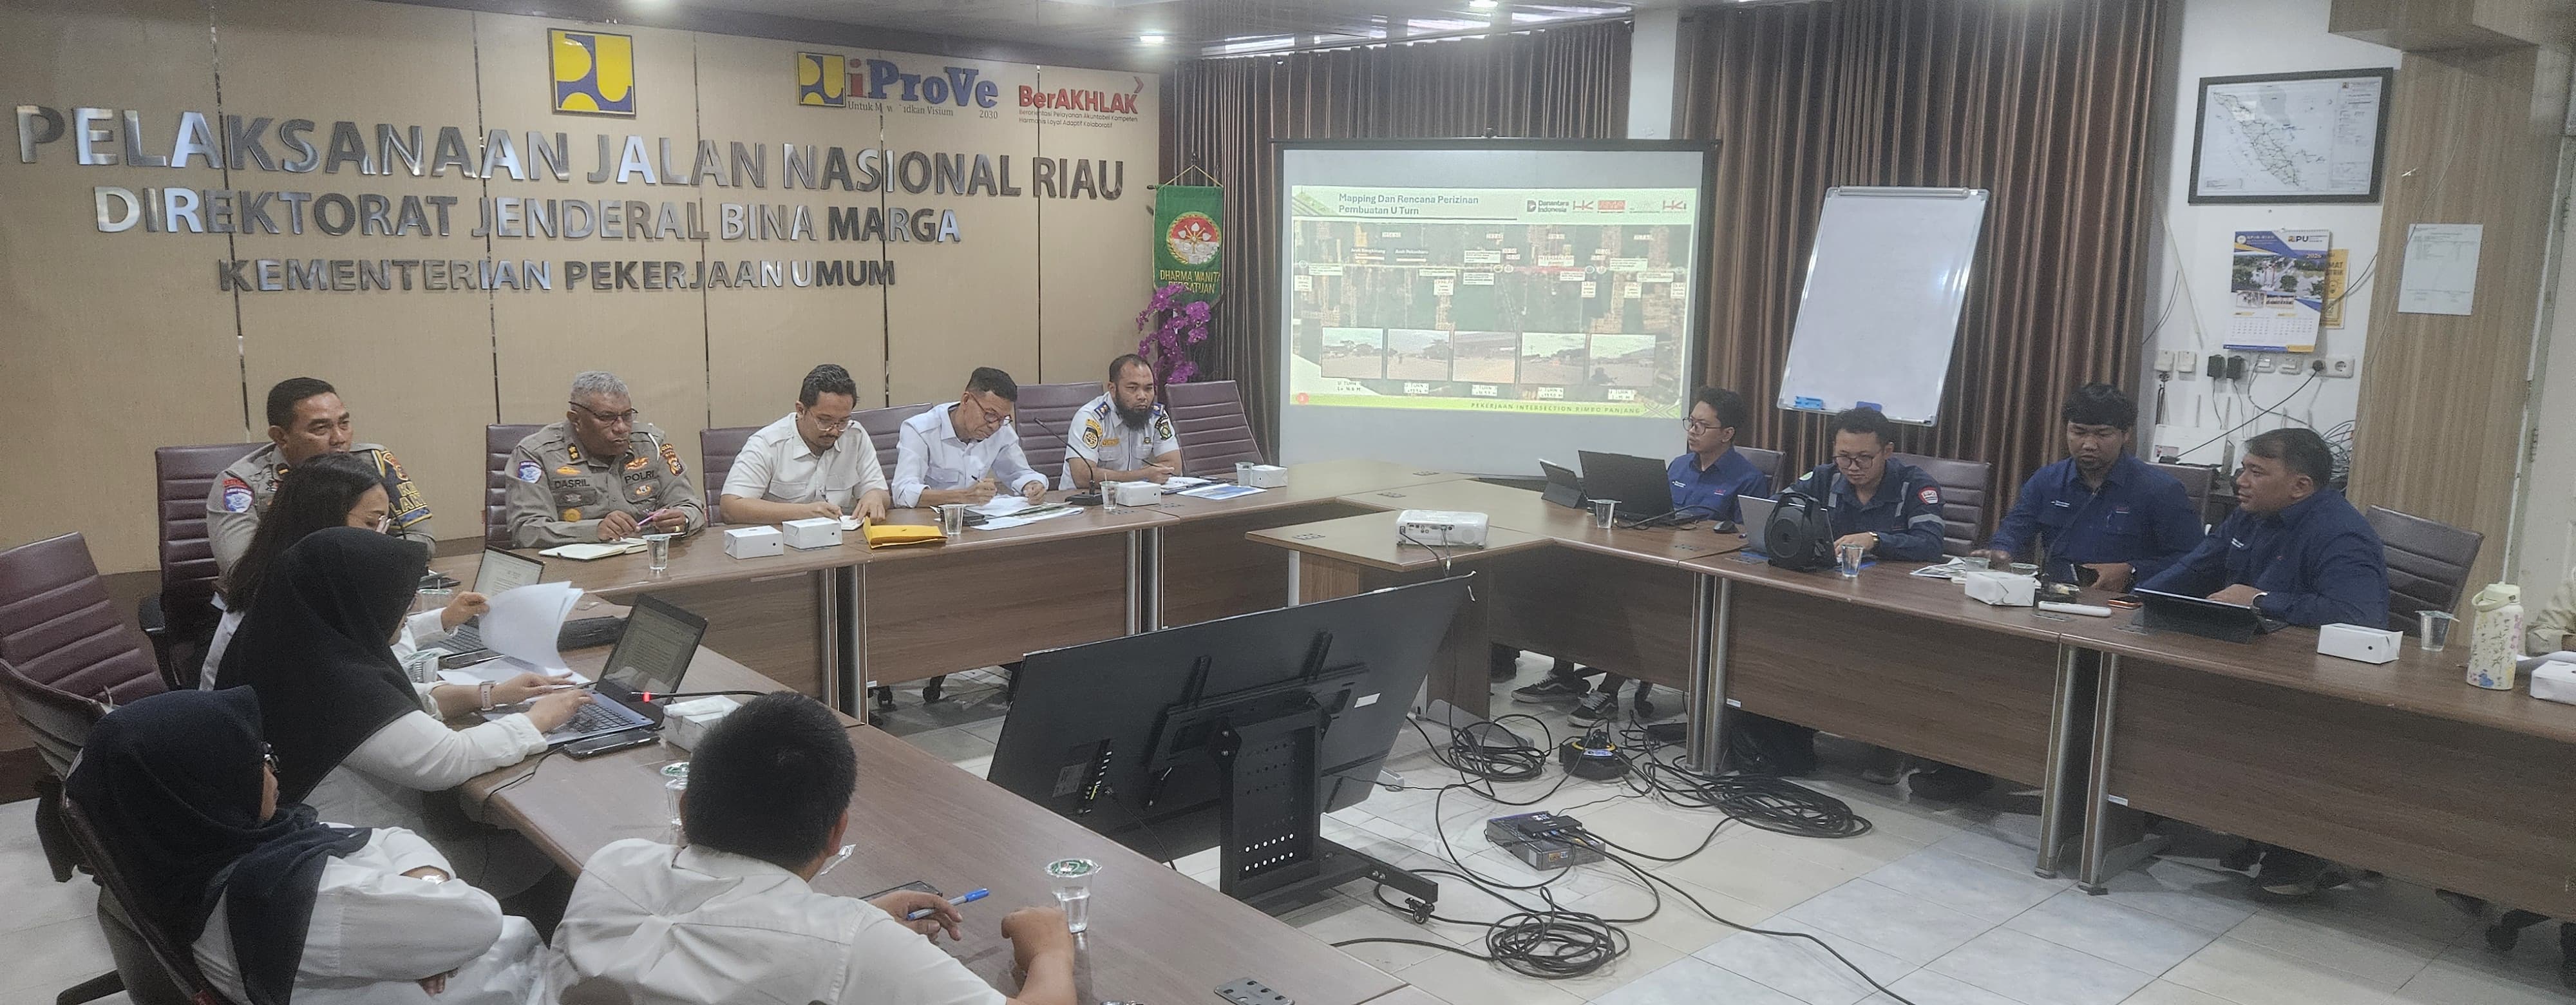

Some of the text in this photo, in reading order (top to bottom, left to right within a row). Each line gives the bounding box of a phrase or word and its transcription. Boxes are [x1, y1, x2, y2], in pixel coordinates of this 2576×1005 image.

[848, 59, 998, 108] iProVe
[1019, 85, 1138, 114] BerAKHLAK
[848, 100, 954, 116] Untuk Mwdkan Visium
[979, 110, 998, 119] 2030
[15, 105, 1124, 201] PELAKSANAAN JALAN NASIONAL RIAU
[1339, 193, 1479, 204] Mapping Dan Rencana Perizinan
[93, 186, 961, 243] DIREKTORAT JENDERAL BINA MARGA
[1339, 205, 1388, 215] Pembuatan
[1399, 206, 1419, 215] Turn
[219, 258, 896, 291] KEMENTERIAN PEKERJAAN UMUM
[1160, 269, 1193, 281] DHARMA
[1168, 281, 1215, 294] SATUAN
[624, 471, 655, 483] POLRI
[554, 479, 591, 490] DASRIL
